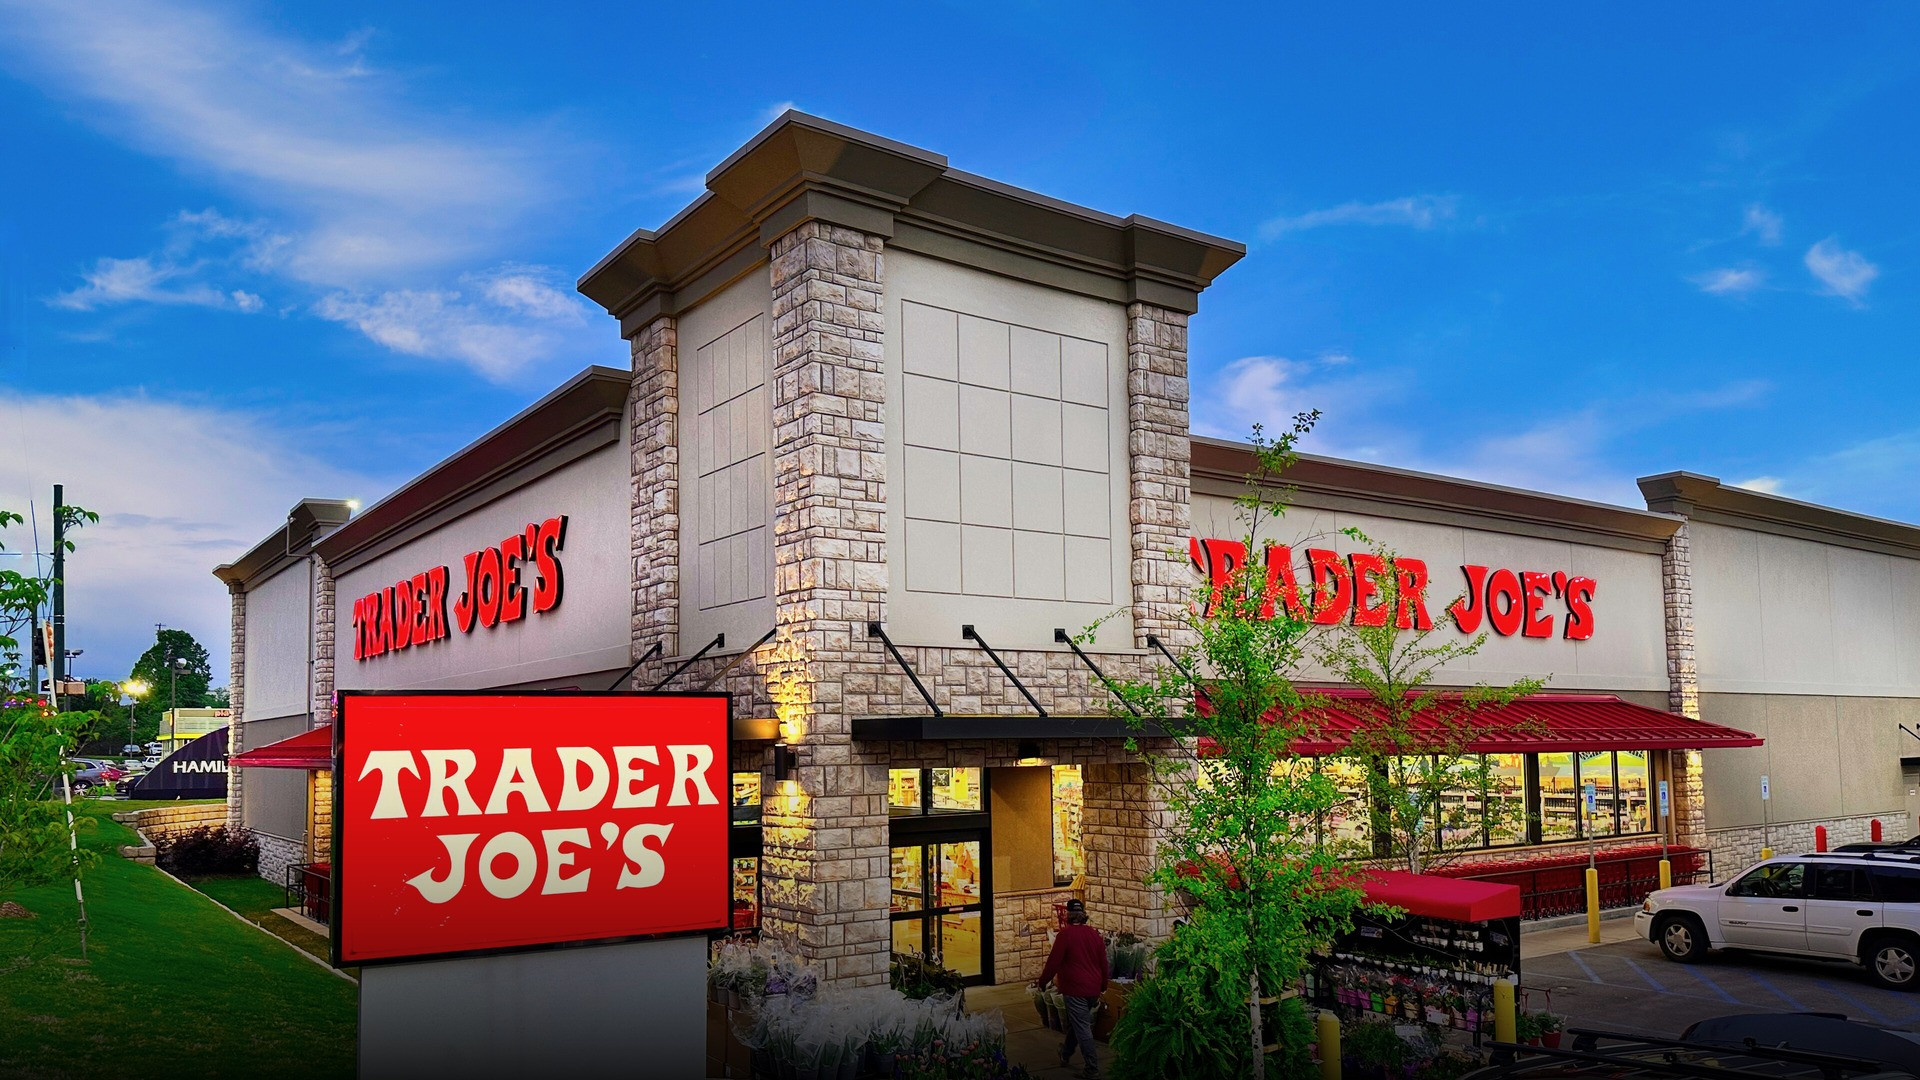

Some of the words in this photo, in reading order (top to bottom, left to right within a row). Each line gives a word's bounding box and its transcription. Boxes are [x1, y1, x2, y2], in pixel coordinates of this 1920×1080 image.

[353, 565, 450, 660] TRADER
[454, 515, 568, 633] JOE'S
[1190, 537, 1433, 630] RADER
[1445, 564, 1597, 640] JOE'S
[358, 744, 720, 820] TRADER
[405, 822, 675, 904] JOE'S
